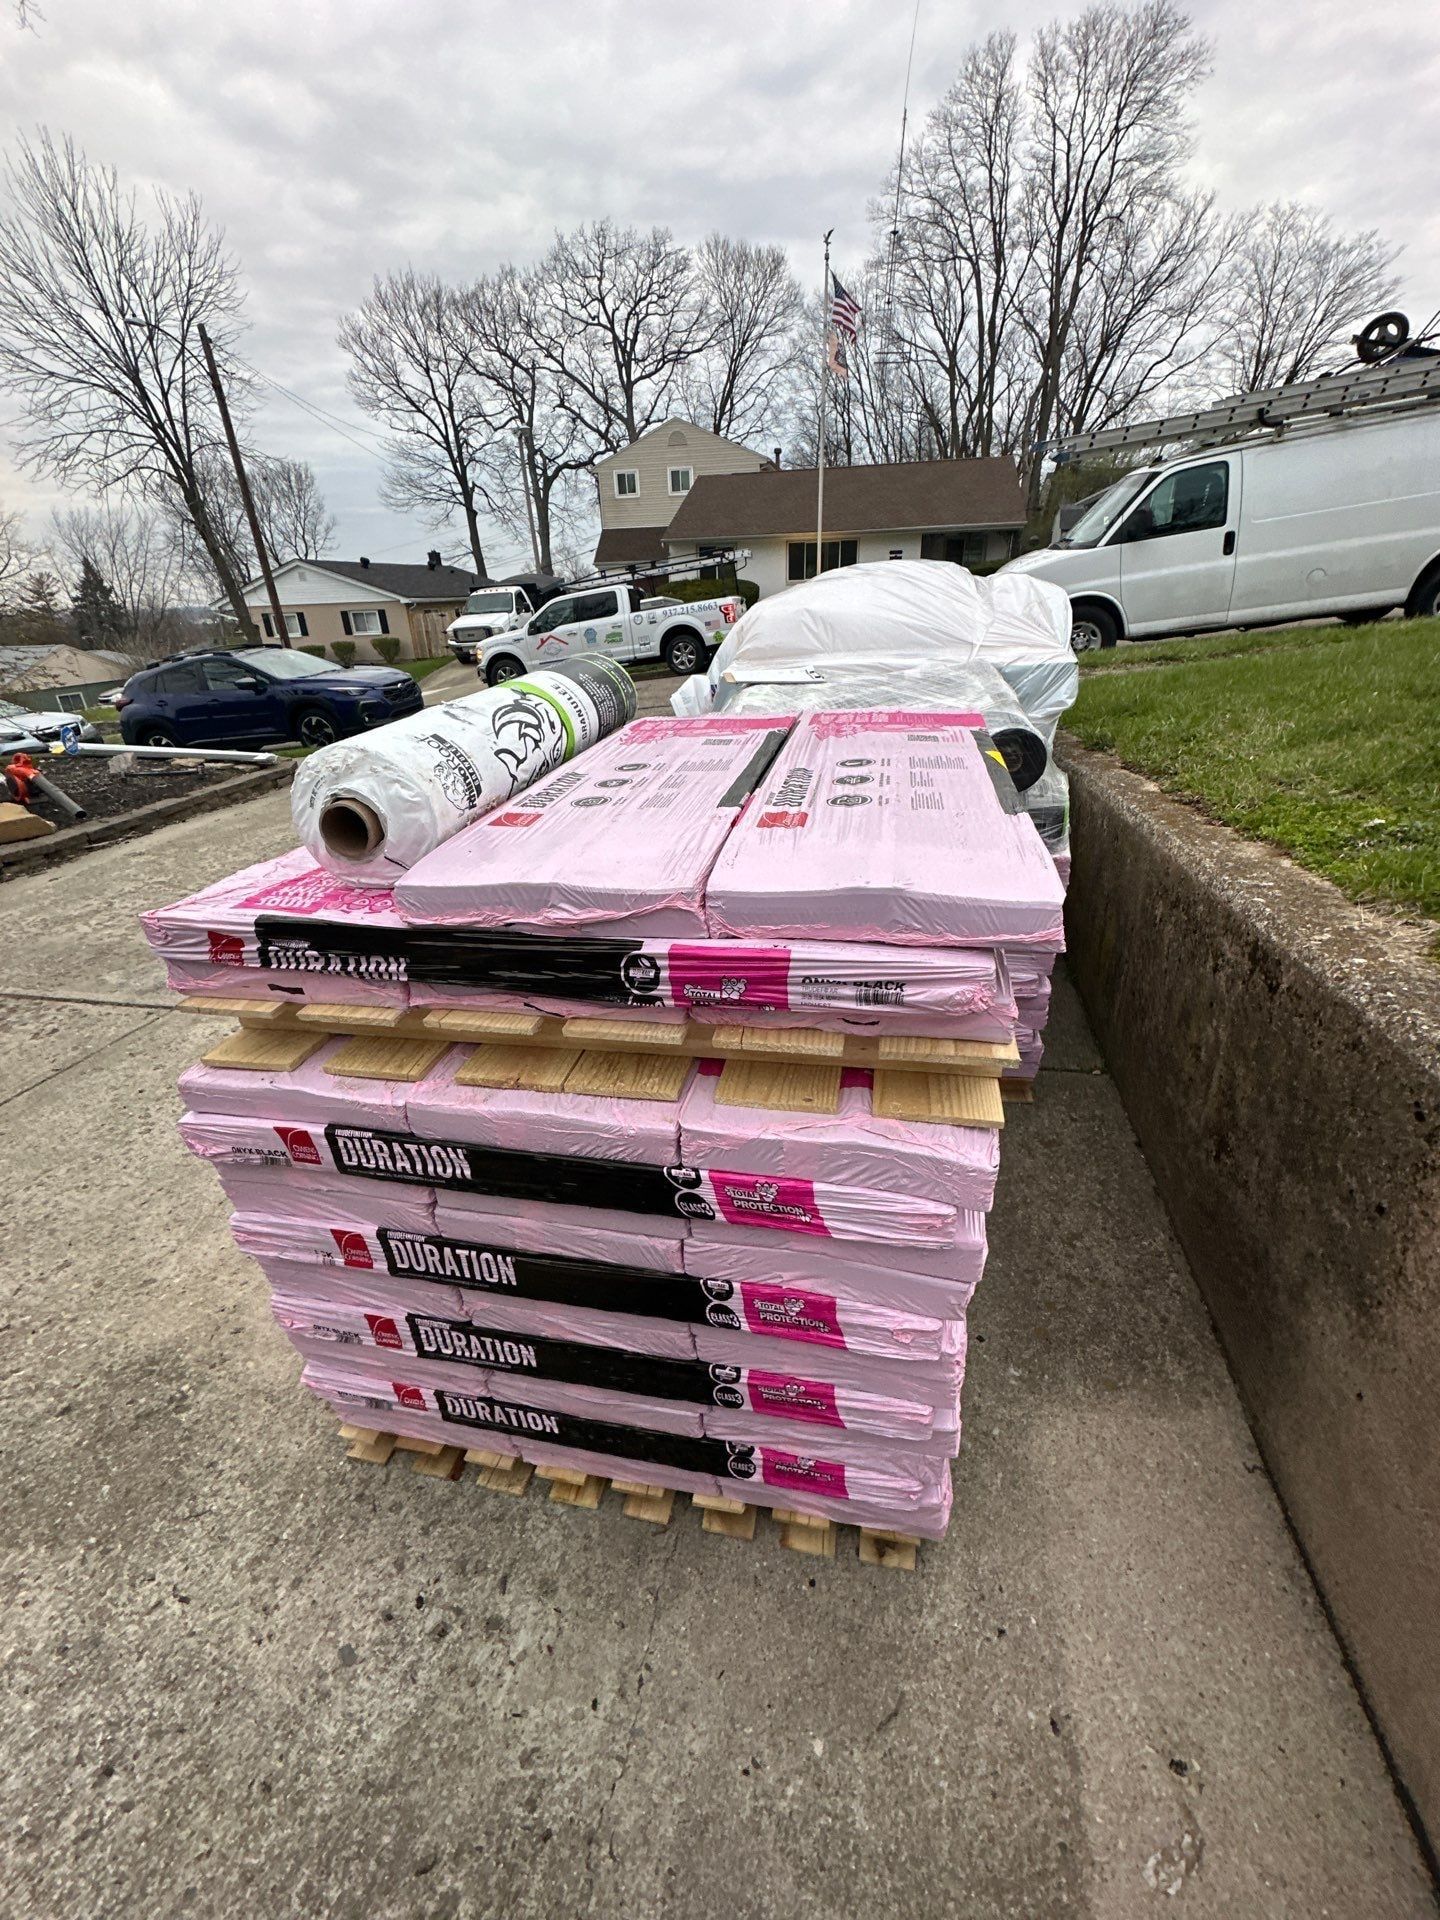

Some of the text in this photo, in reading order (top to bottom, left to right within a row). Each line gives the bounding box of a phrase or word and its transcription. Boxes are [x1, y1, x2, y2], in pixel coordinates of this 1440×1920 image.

[662, 602, 718, 617] 937.215.8663
[414, 736, 477, 810] RhinoRoof
[292, 1144, 317, 1154] OWENS
[336, 1136, 472, 1180] DURATION
[732, 1189, 757, 1199] TOTAL
[733, 1199, 804, 1216] PROTECTION
[388, 1240, 517, 1286] DURATION
[760, 1302, 783, 1311] TOTAL
[760, 1311, 824, 1328] PROTECTION
[418, 1326, 537, 1368] DURATION
[444, 1396, 559, 1434] DURATION
